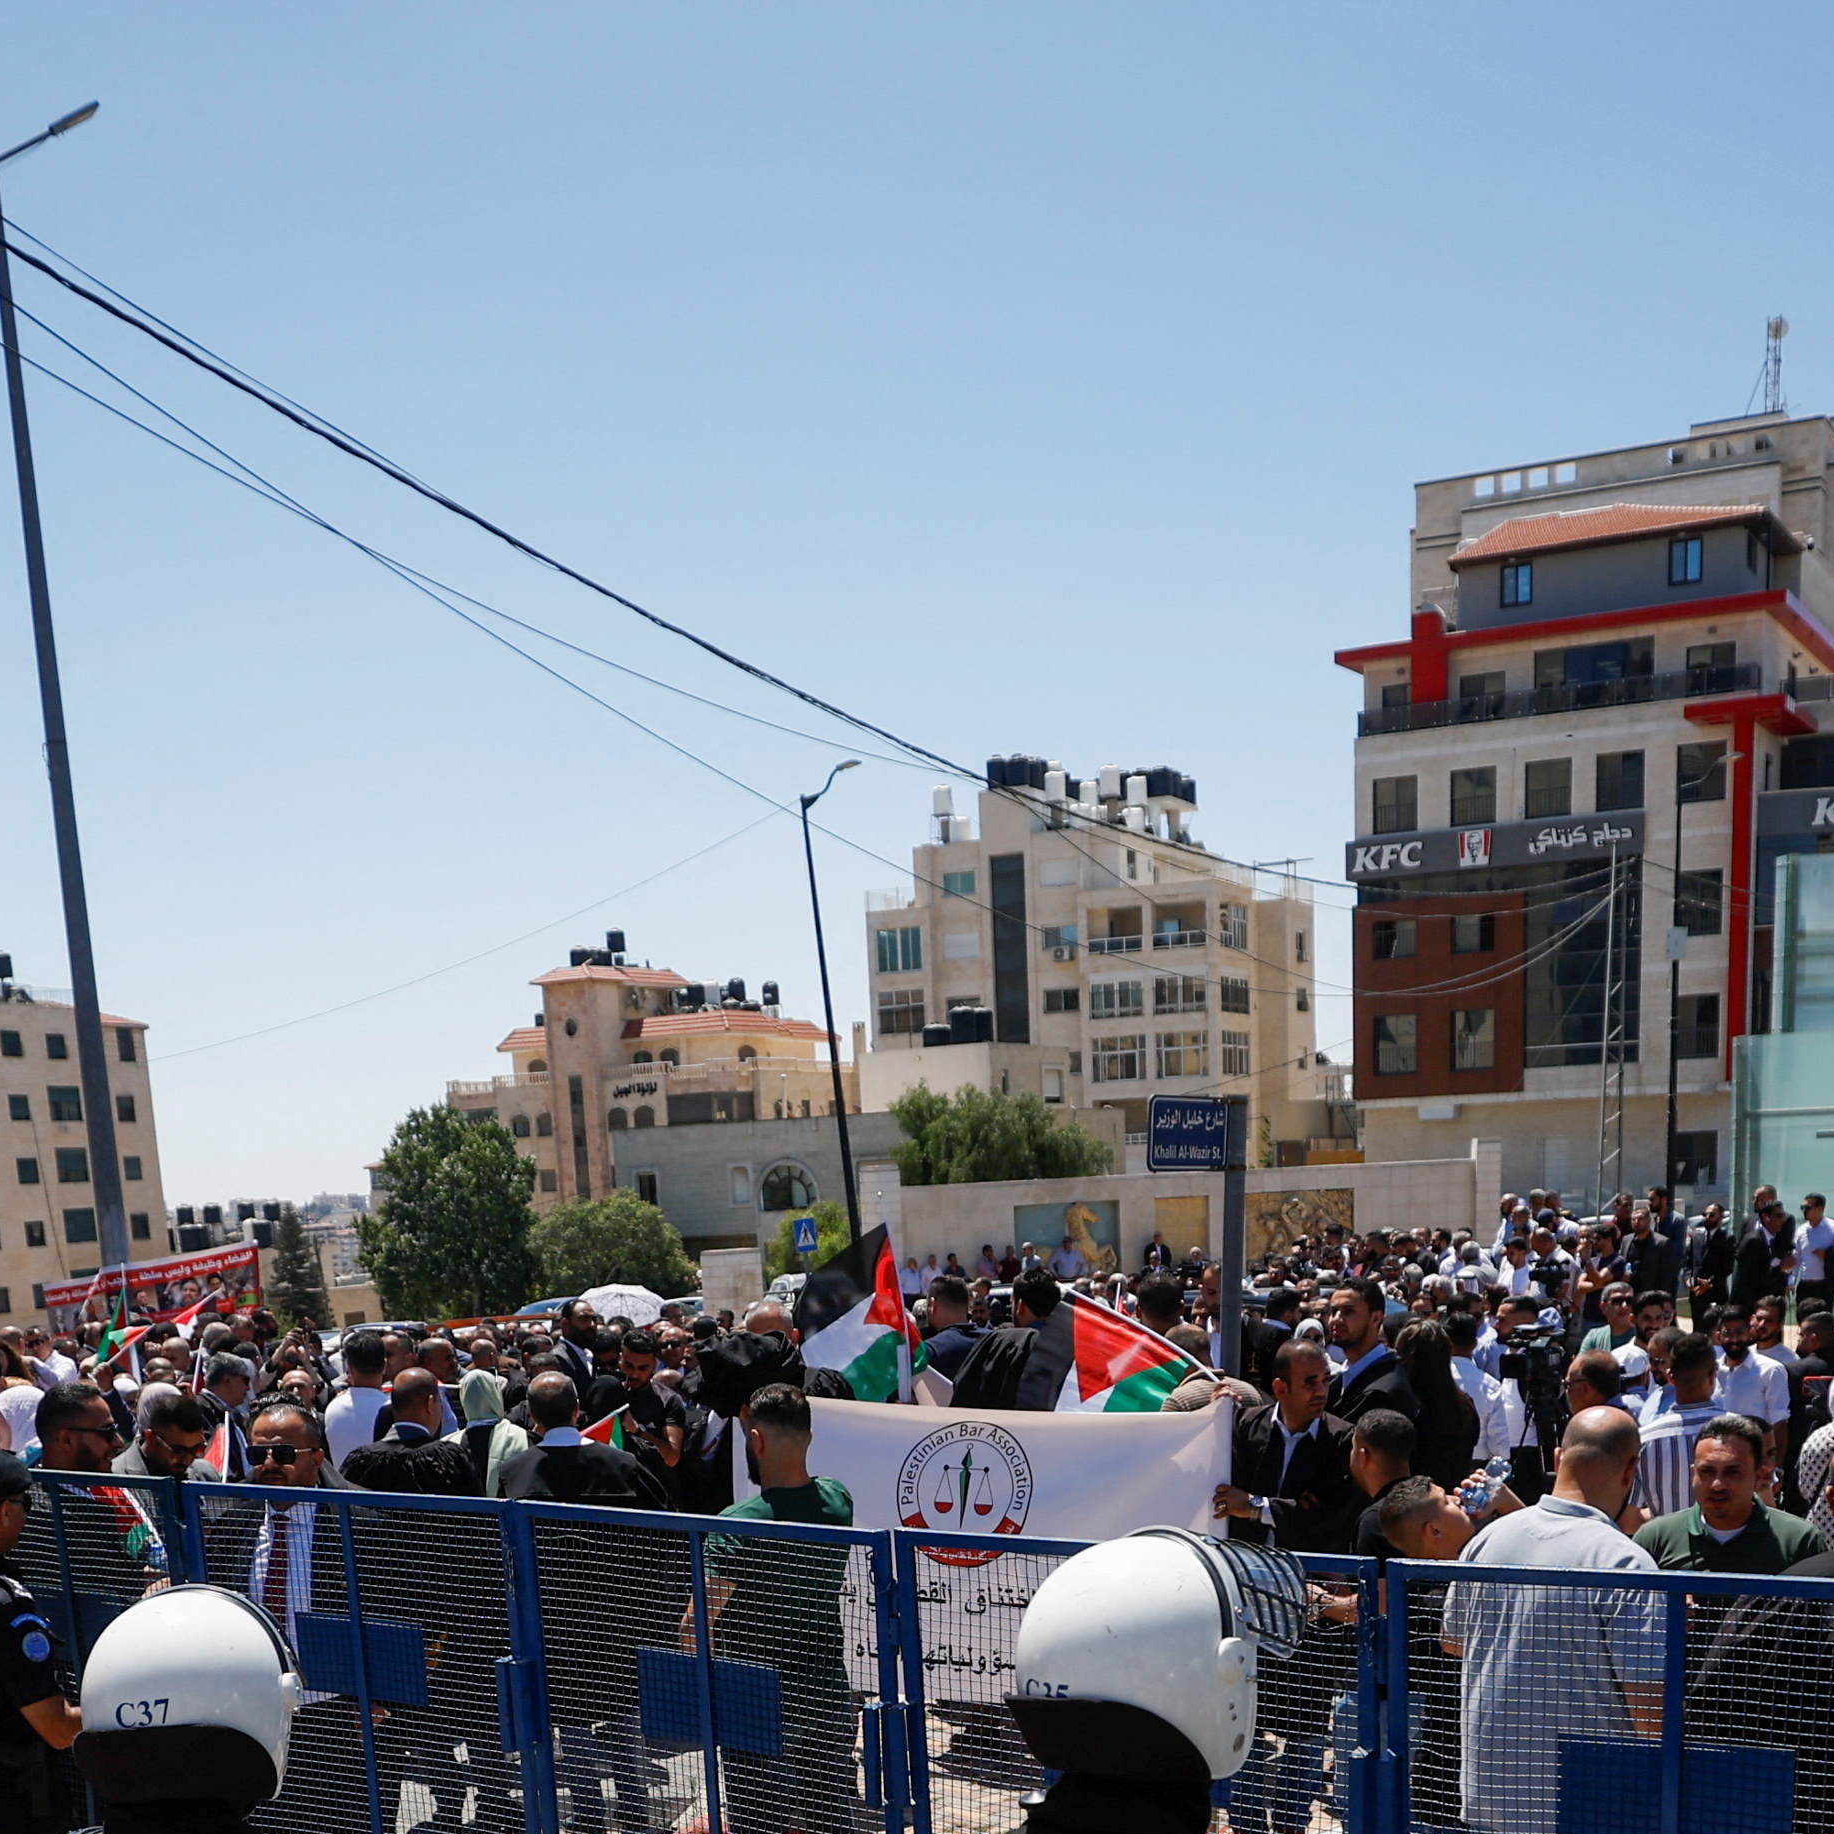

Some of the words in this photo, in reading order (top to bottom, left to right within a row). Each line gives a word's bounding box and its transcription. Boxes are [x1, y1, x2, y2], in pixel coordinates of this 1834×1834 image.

[1528, 825, 1587, 855] كنتاكي
[1593, 822, 1633, 847] دجاج
[1352, 841, 1423, 873] KFC
[1155, 1108, 1181, 1129] الوزير
[1182, 1108, 1204, 1130] خليل
[1205, 1109, 1224, 1131] شارع
[1154, 1143, 1177, 1159] Khalil
[1178, 1143, 1211, 1159] Al-Wazir
[1212, 1145, 1223, 1159] St.
[901, 1430, 955, 1506] Palestinian
[959, 1423, 985, 1438] Bar
[986, 1428, 1031, 1511] Association
[964, 1584, 1037, 1614] ختناق
[115, 1698, 169, 1728] C37
